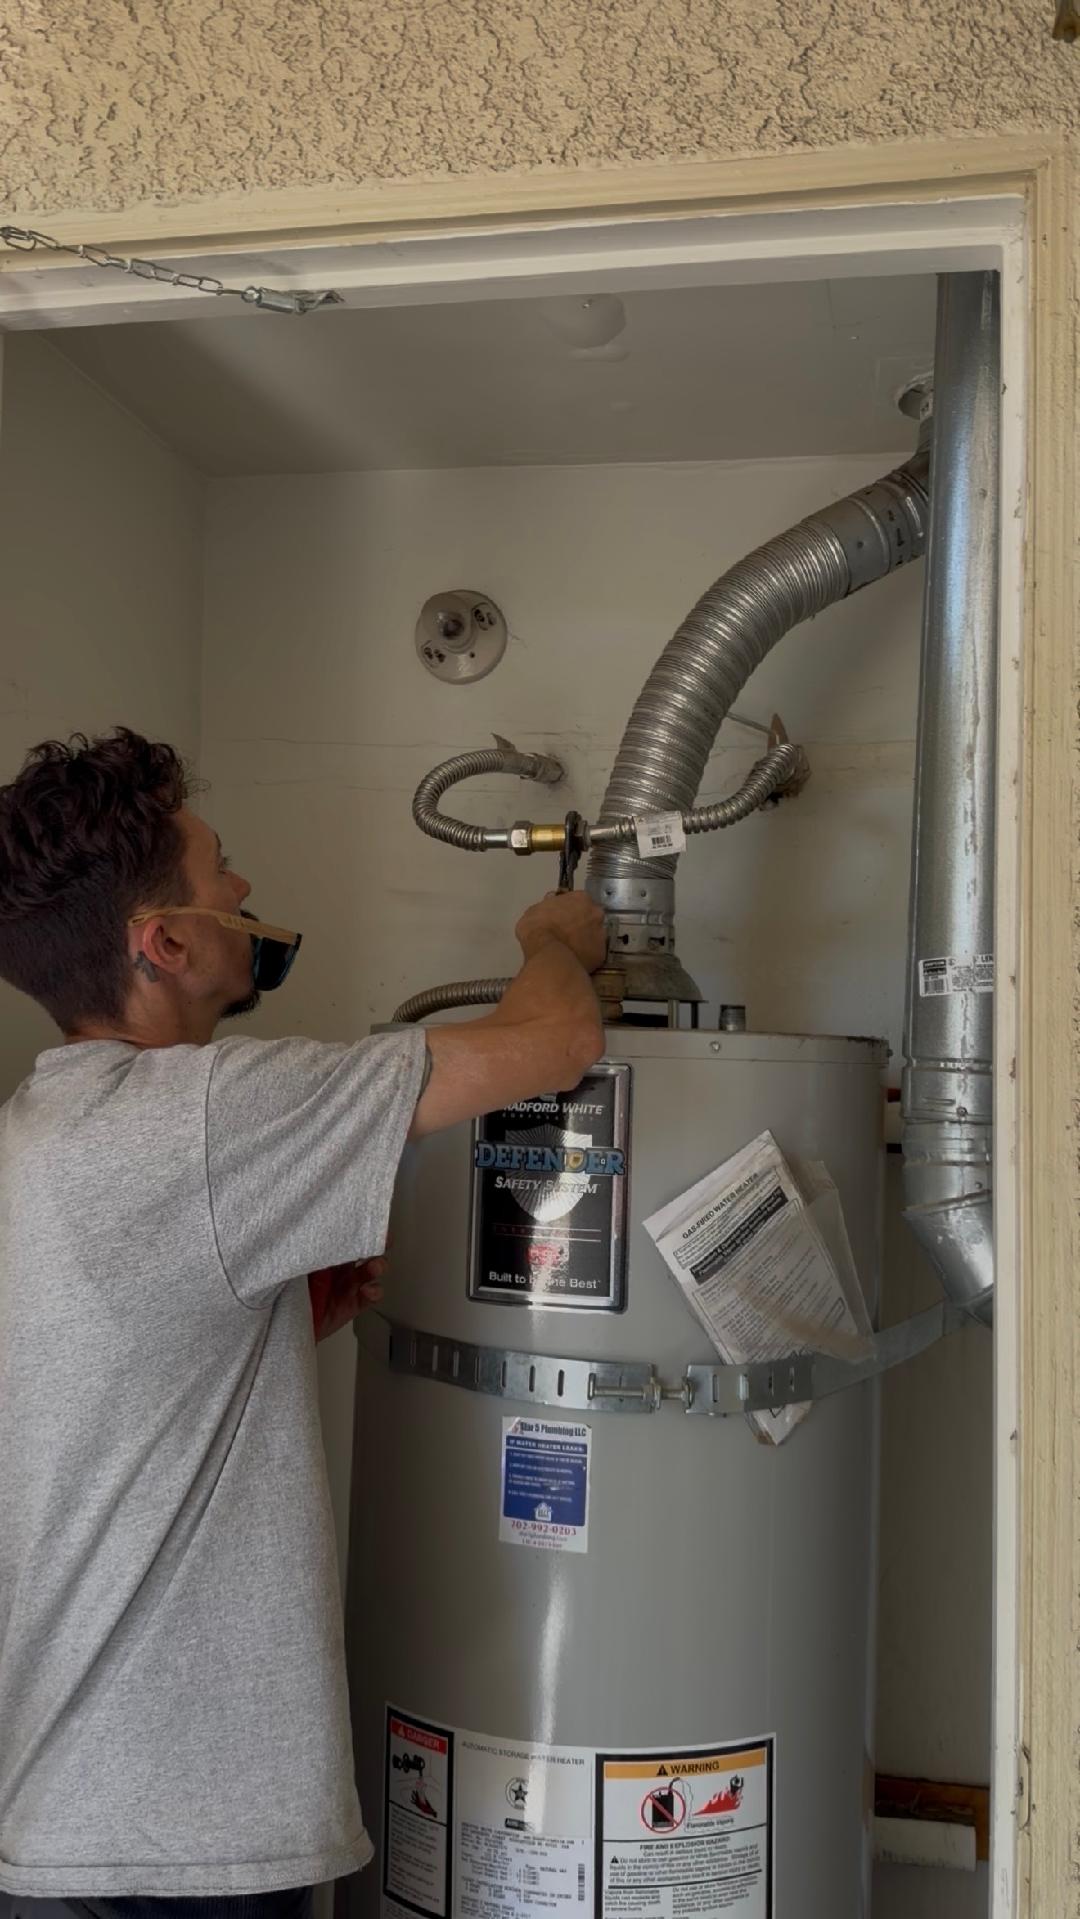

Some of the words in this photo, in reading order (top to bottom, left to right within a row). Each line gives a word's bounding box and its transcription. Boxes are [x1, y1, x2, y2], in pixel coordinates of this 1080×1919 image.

[503, 1102, 560, 1113] RADFORD
[562, 1103, 605, 1115] WHITE
[475, 1141, 625, 1175] DEFENDER
[494, 1175, 541, 1191] SAFETY
[489, 1271, 512, 1283] Built
[514, 1274, 526, 1284] to
[569, 1279, 597, 1289] Best
[574, 1426, 587, 1437] LLC
[406, 1728, 440, 1751] DANGER
[461, 1741, 498, 1755] AUTOMATIC
[499, 1749, 530, 1760] STORAGE
[557, 1758, 585, 1766] HEATER
[670, 1761, 720, 1775] WARNING
